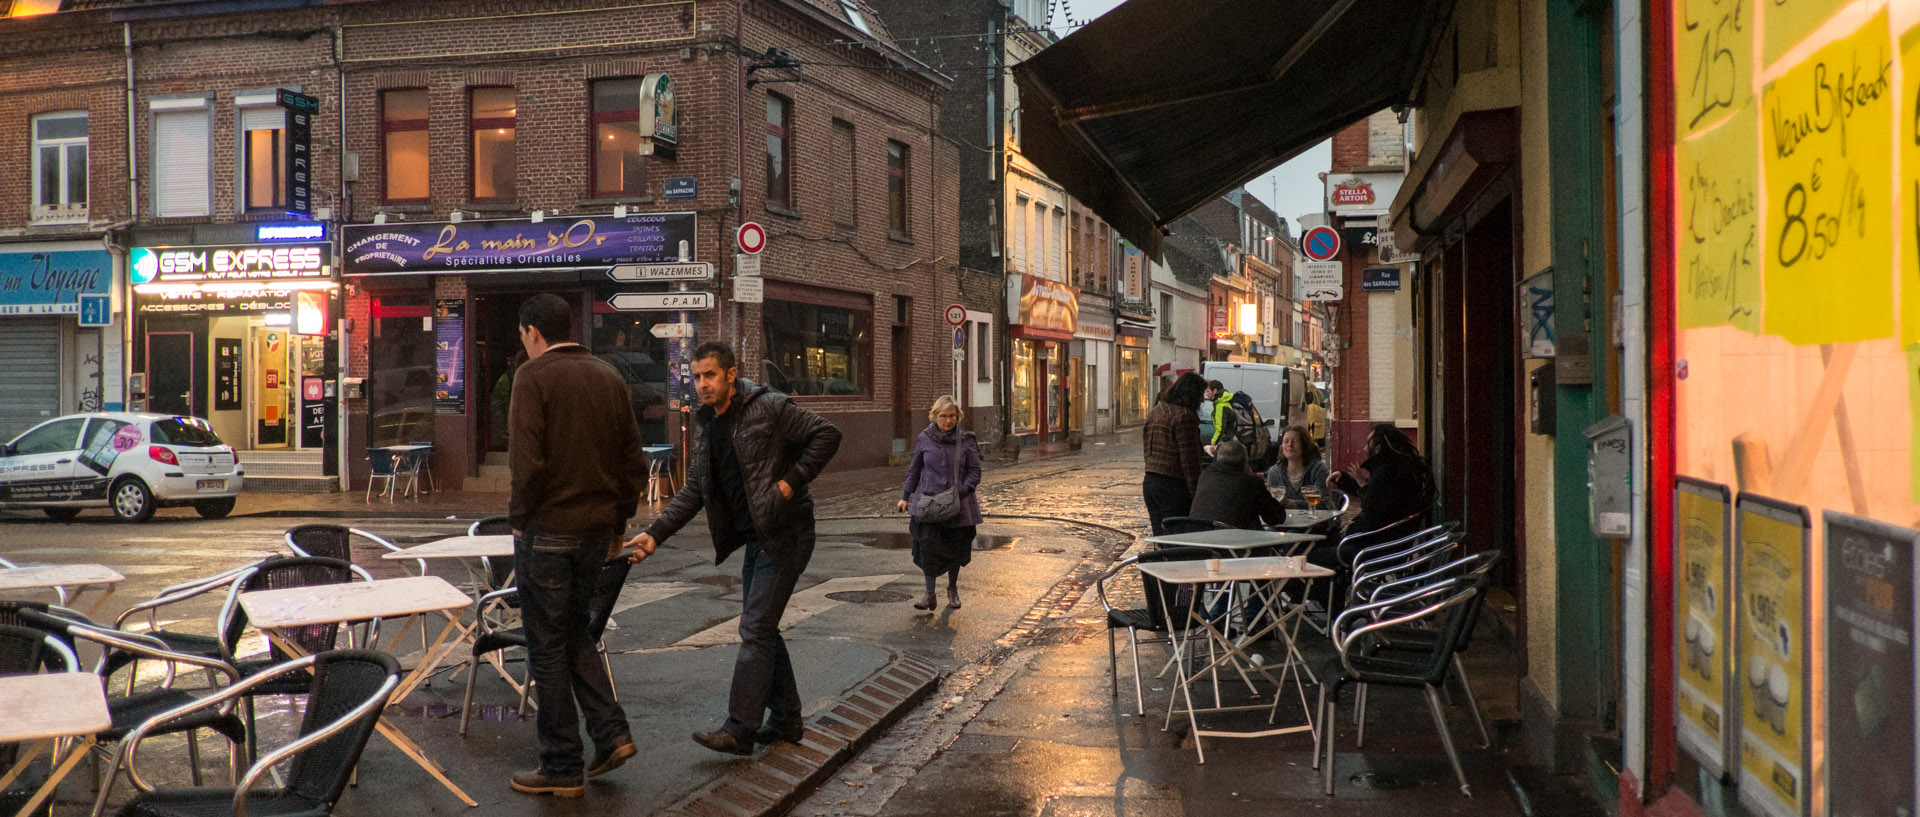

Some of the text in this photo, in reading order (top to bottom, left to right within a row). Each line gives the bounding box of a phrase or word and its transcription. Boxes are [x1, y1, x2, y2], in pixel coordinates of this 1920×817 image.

[282, 93, 318, 111] GSM
[347, 233, 420, 253] CHANGEMENT
[422, 219, 607, 260] La main d'Or
[627, 235, 665, 243] GRILLADES
[375, 242, 387, 250] DE
[159, 248, 321, 273] GSM EXPRESS
[354, 252, 407, 267] PROPRIETAIRE
[445, 253, 581, 267] Spécialités Orientales
[650, 266, 703, 276] WAZEMMES
[3, 253, 100, 305] un Voyage
[160, 290, 201, 299] VENTE
[140, 302, 225, 312] ACCESSOIRES
[662, 297, 703, 306] C.P.A.M.
[266, 374, 277, 384] SFR
[116, 437, 134, 450] 30
